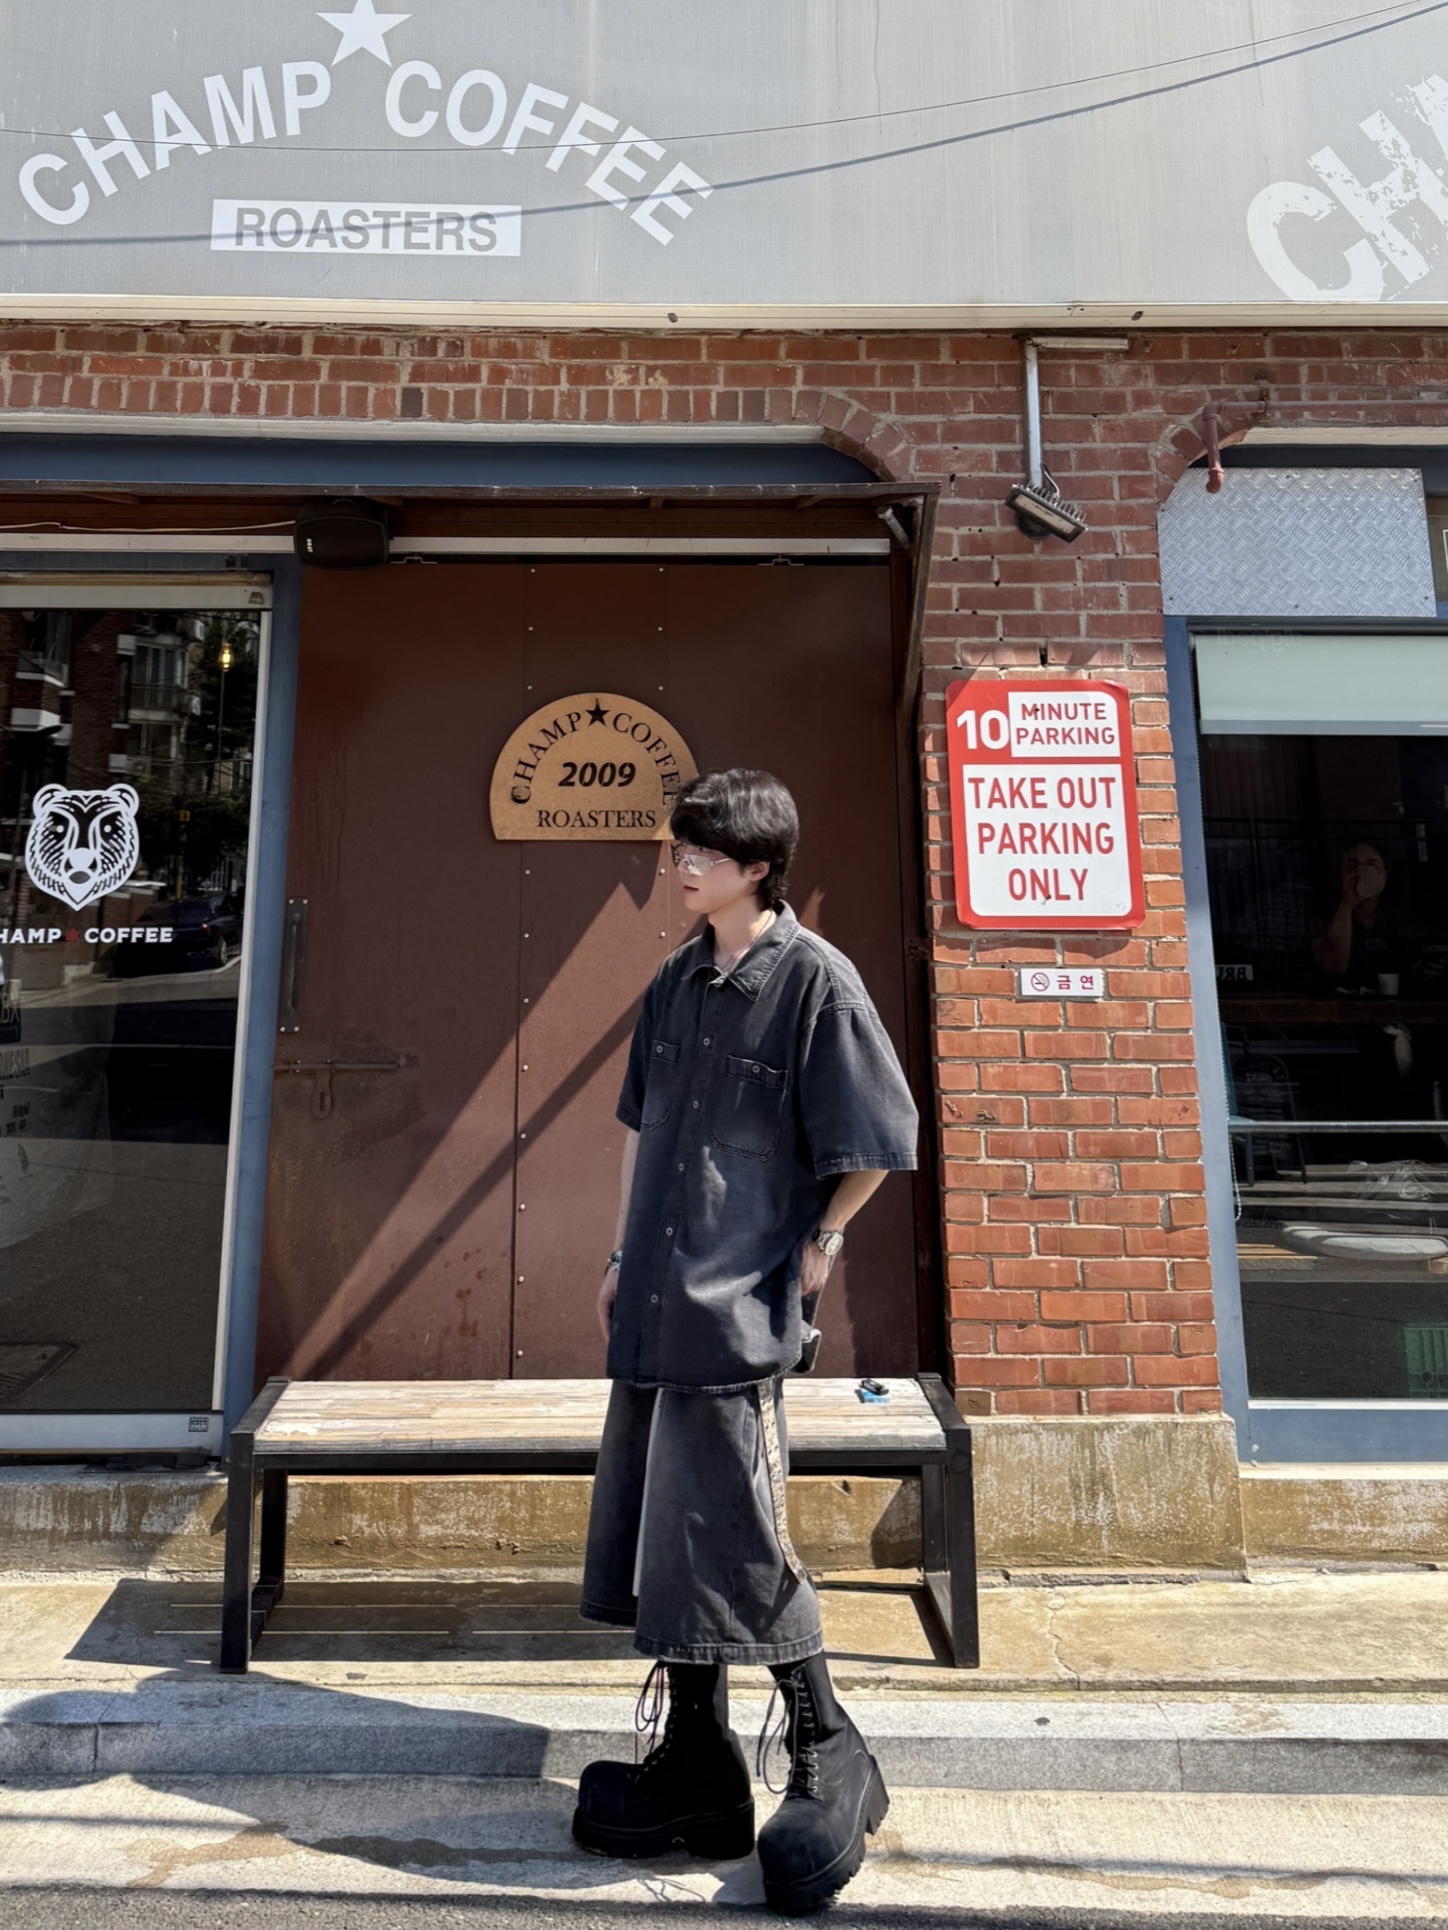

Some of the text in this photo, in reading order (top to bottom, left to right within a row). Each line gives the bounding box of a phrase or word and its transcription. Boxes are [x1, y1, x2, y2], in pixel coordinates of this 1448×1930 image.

[19, 60, 714, 247] CHAMP COFFEE
[235, 207, 498, 252] ROASTERS
[1021, 703, 1107, 721] MINUTE
[957, 710, 1010, 749] 10
[1015, 727, 1115, 745] PARKING
[511, 711, 582, 805] CHAMP
[558, 762, 636, 787] 2009
[968, 777, 1116, 809] TAKE OUT
[537, 810, 656, 828] ROASTERS
[977, 822, 1115, 855] PARKING
[1008, 868, 1089, 901] ONLY
[84, 926, 174, 944] COFFEE
